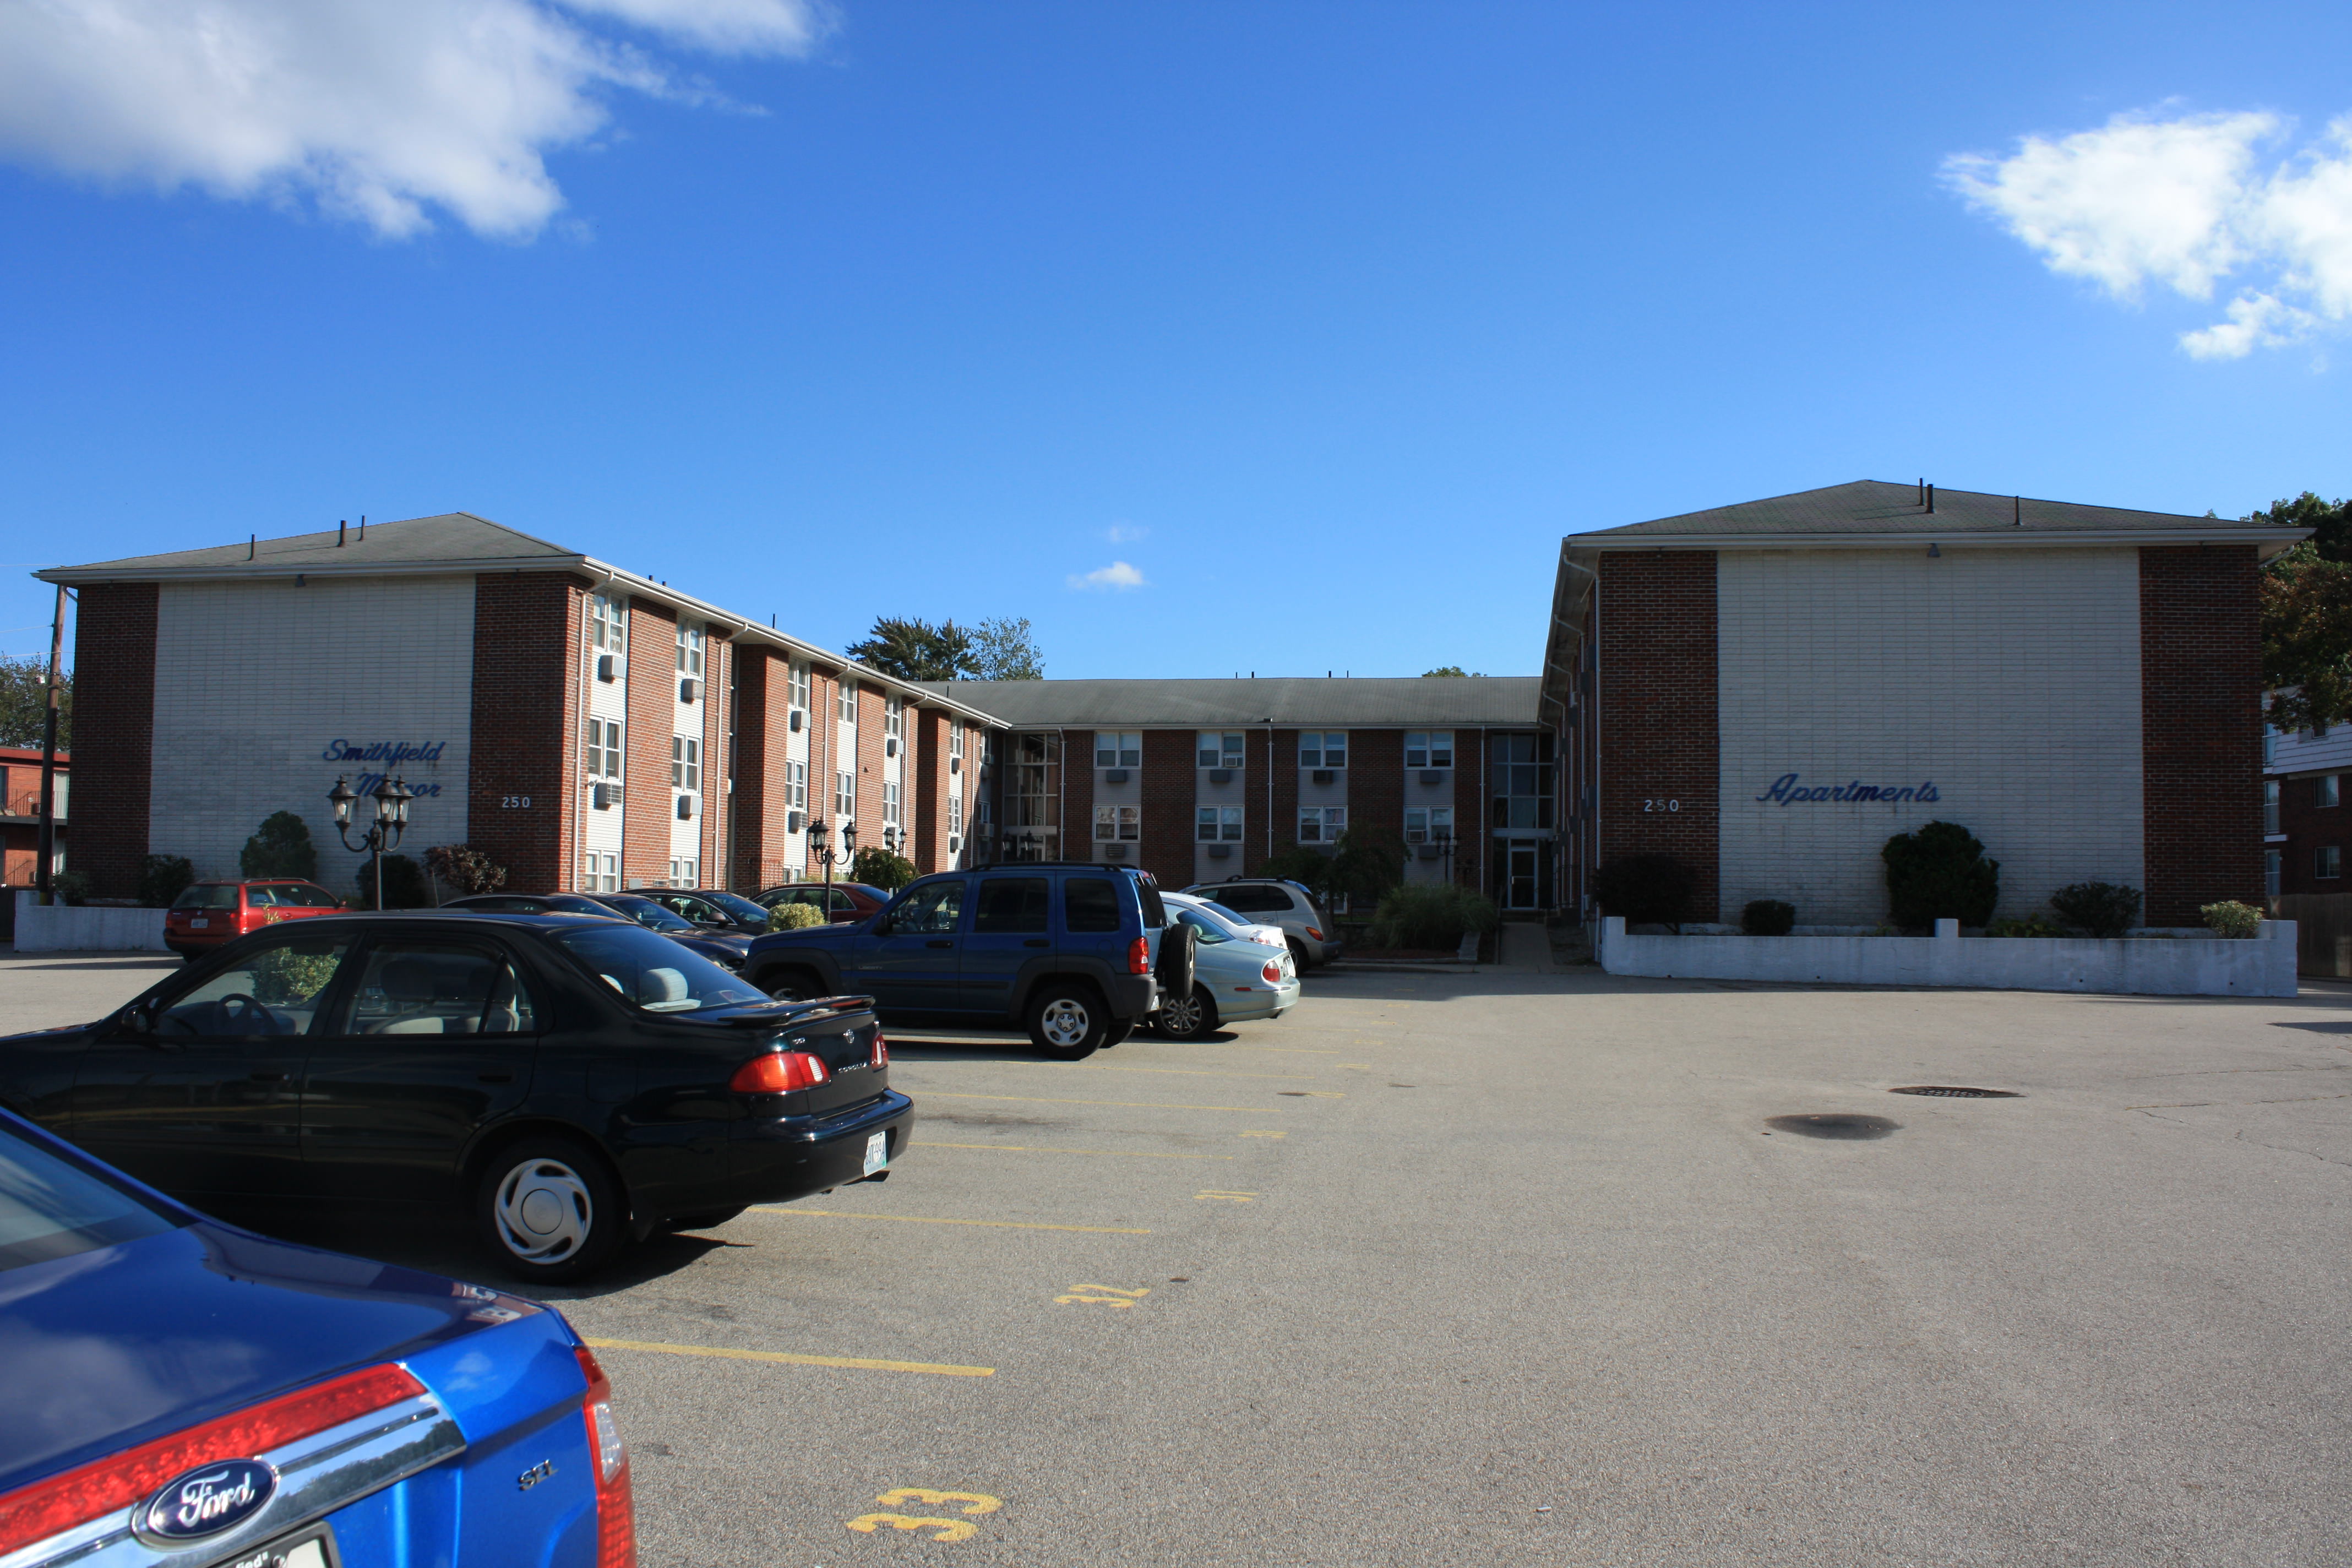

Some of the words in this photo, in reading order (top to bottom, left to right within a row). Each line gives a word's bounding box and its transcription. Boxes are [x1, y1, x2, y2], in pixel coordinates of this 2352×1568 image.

[322, 738, 446, 767] Smithfield
[356, 772, 441, 798] Mor
[1756, 773, 1940, 806] Apartments
[502, 796, 531, 808] 250
[1644, 799, 1679, 812] 250
[1052, 1283, 1150, 1309] 32
[519, 1458, 559, 1491] SEL
[178, 1470, 256, 1528] Ford
[846, 1486, 1004, 1541] 33
